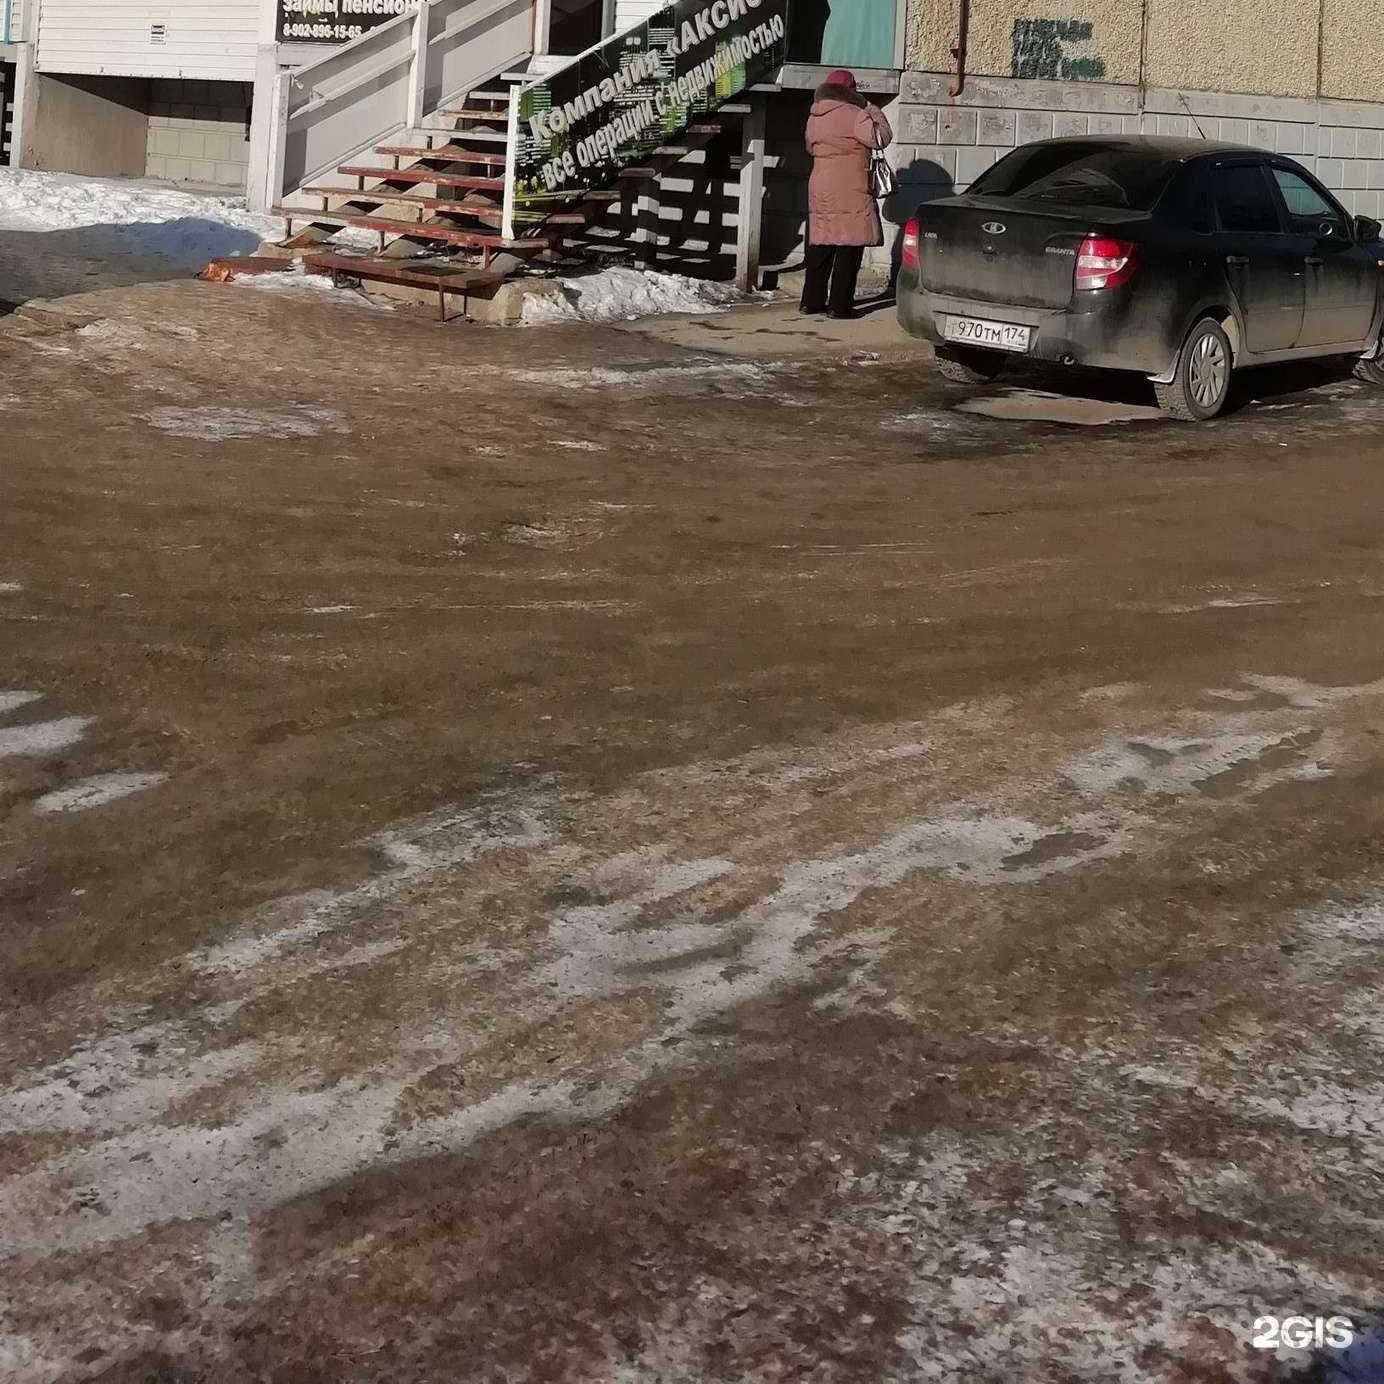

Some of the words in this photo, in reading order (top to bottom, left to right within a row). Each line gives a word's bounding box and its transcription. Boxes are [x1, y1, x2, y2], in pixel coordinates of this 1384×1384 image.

[529, 48, 660, 143] Компания
[541, 154, 576, 191] все
[576, 100, 658, 167] операции
[655, 93, 667, 116] с
[669, 13, 785, 109] недвижимостью
[1004, 327, 1025, 341] 174
